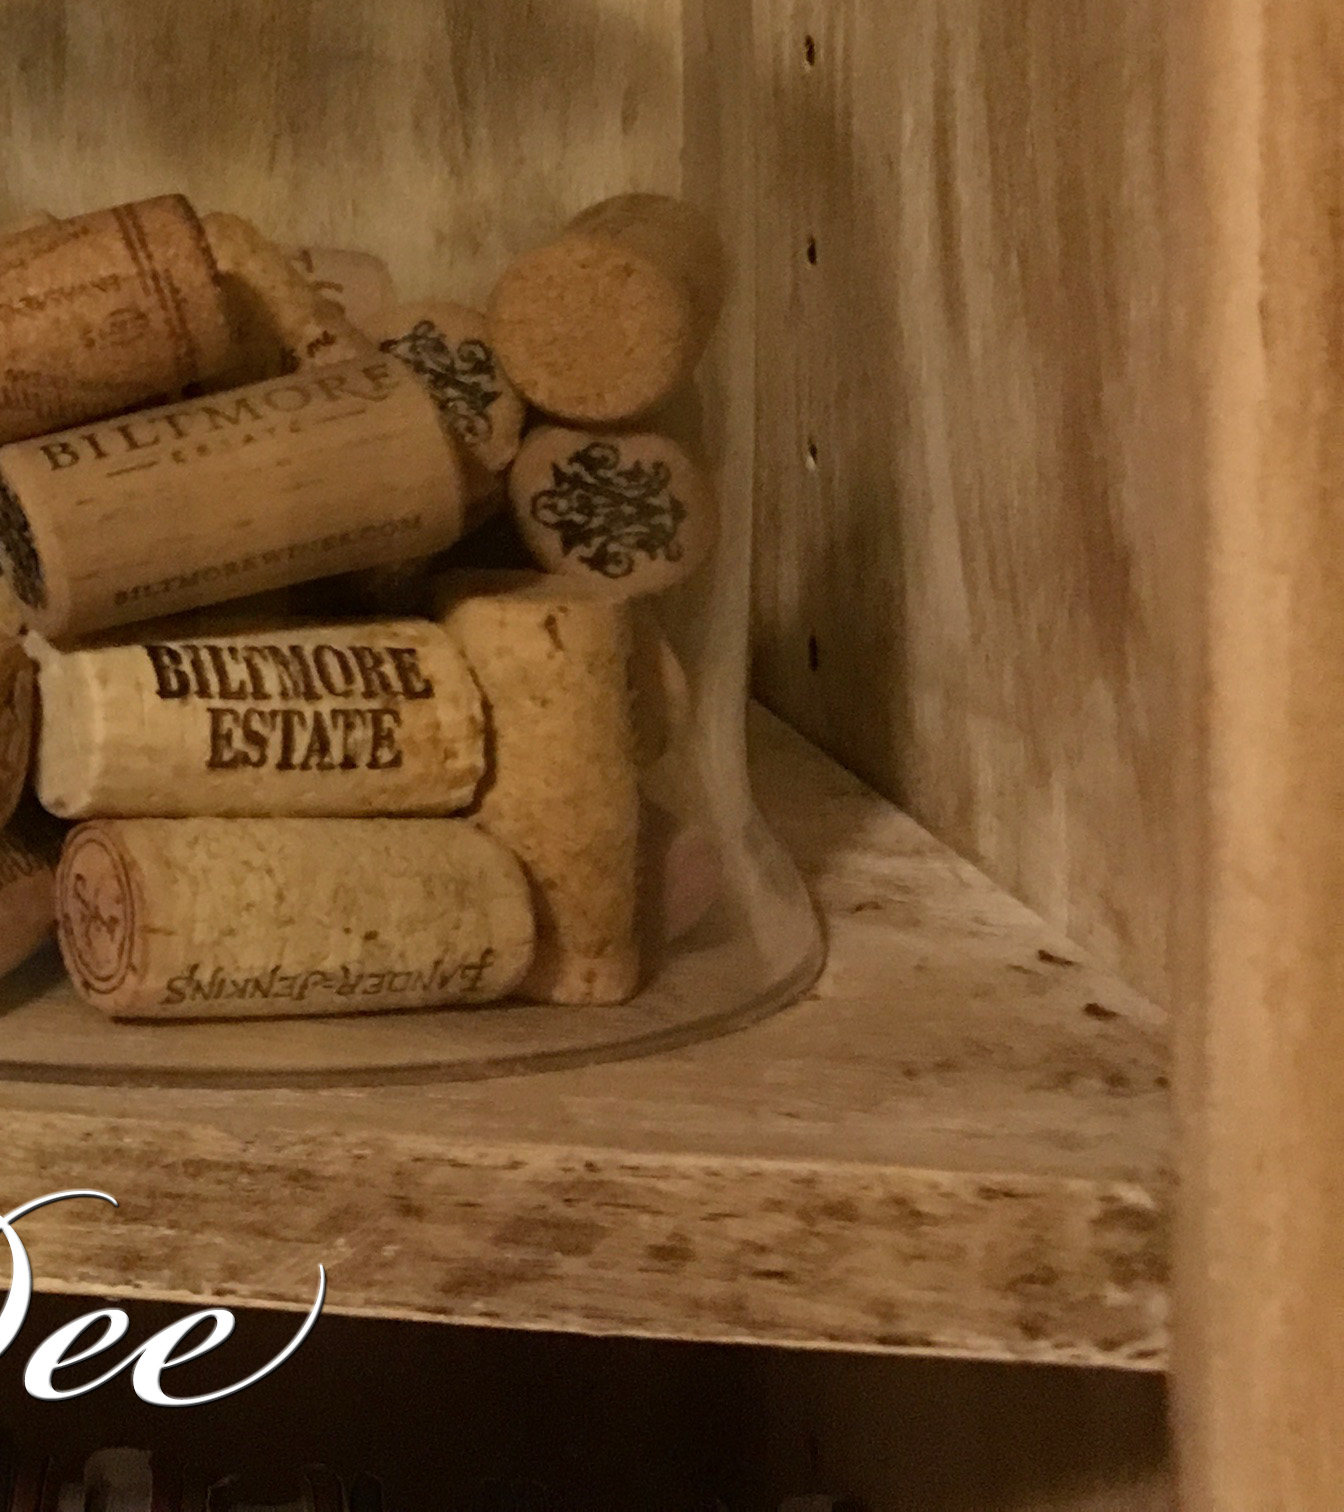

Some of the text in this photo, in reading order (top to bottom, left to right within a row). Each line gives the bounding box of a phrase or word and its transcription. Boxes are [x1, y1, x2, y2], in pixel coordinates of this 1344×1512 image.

[40, 361, 404, 473] BILTMORE
[144, 644, 435, 701] BILTMORE
[206, 709, 404, 771] ESTATE
